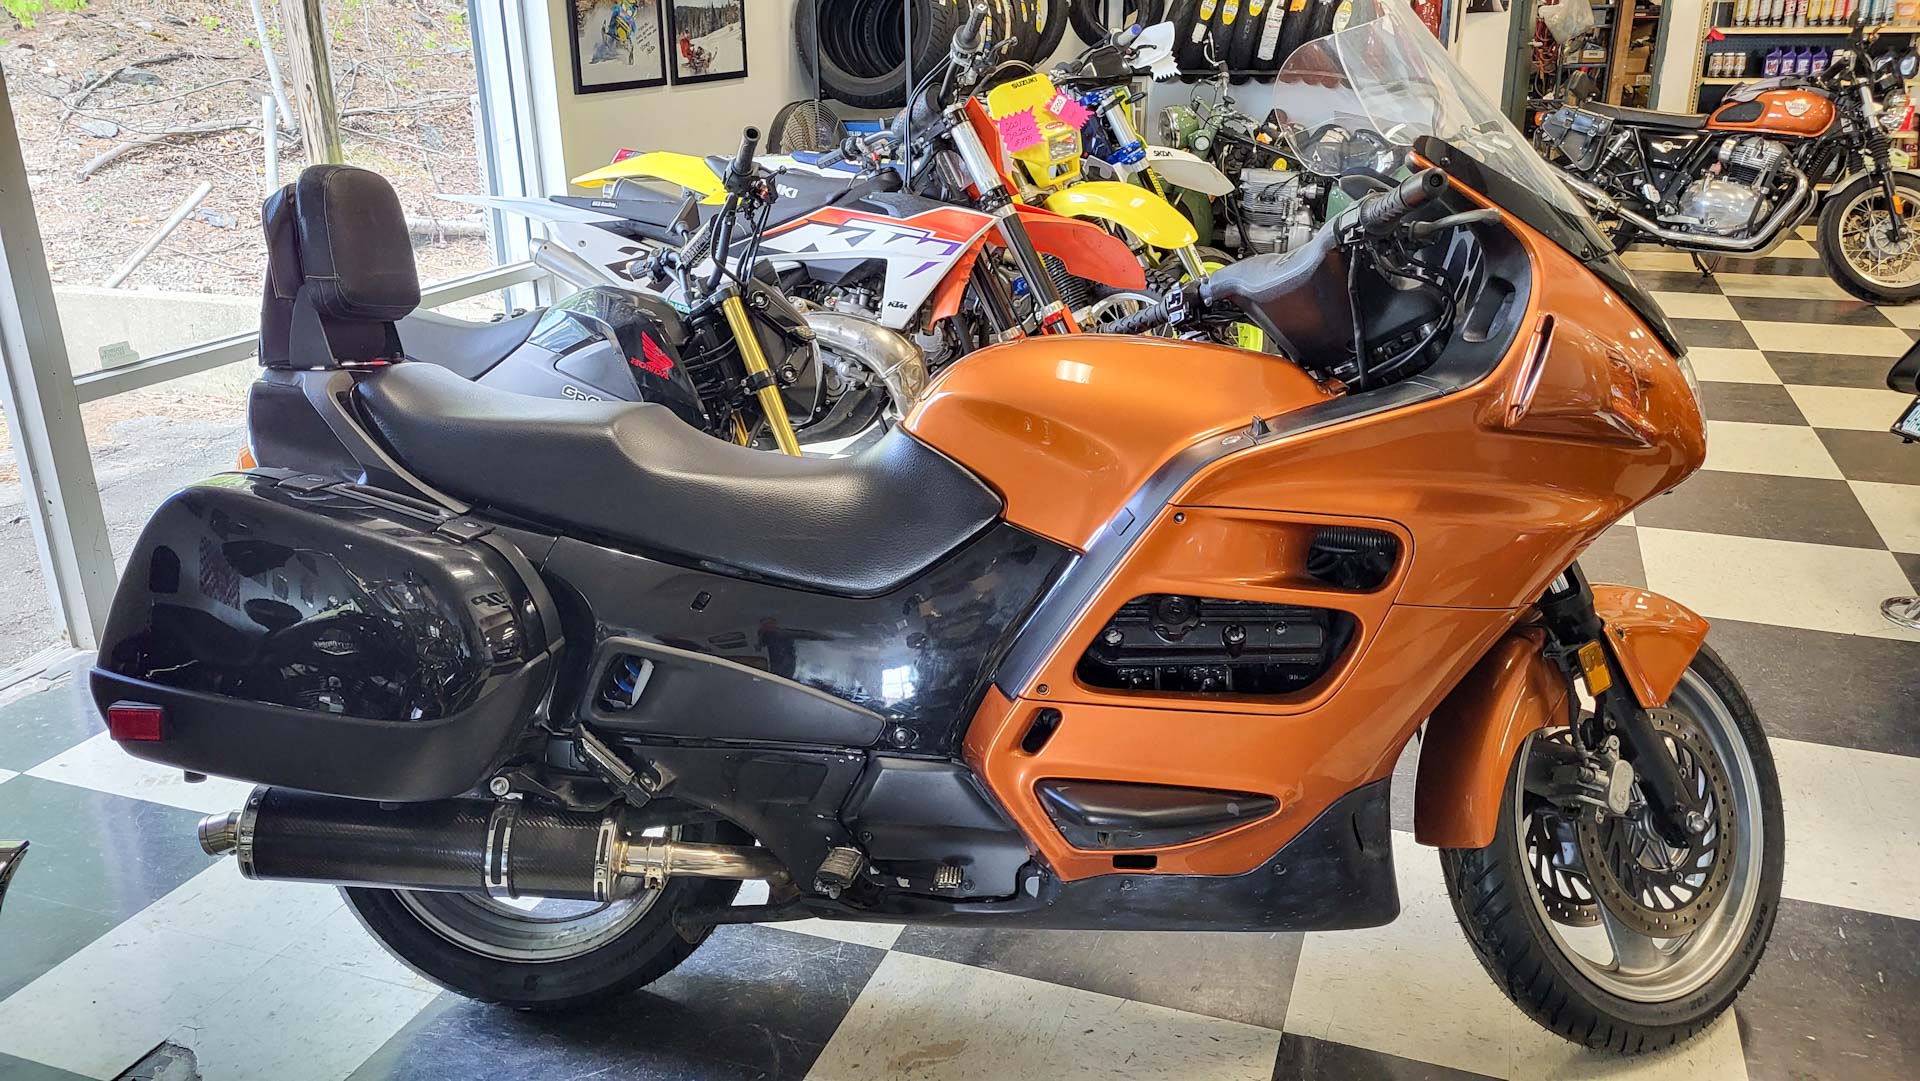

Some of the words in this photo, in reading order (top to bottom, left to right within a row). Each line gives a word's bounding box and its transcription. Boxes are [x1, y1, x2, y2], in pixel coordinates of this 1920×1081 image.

[1011, 77, 1038, 89] SUZUKI
[887, 300, 908, 310] KTM
[630, 357, 670, 380] HONDA
